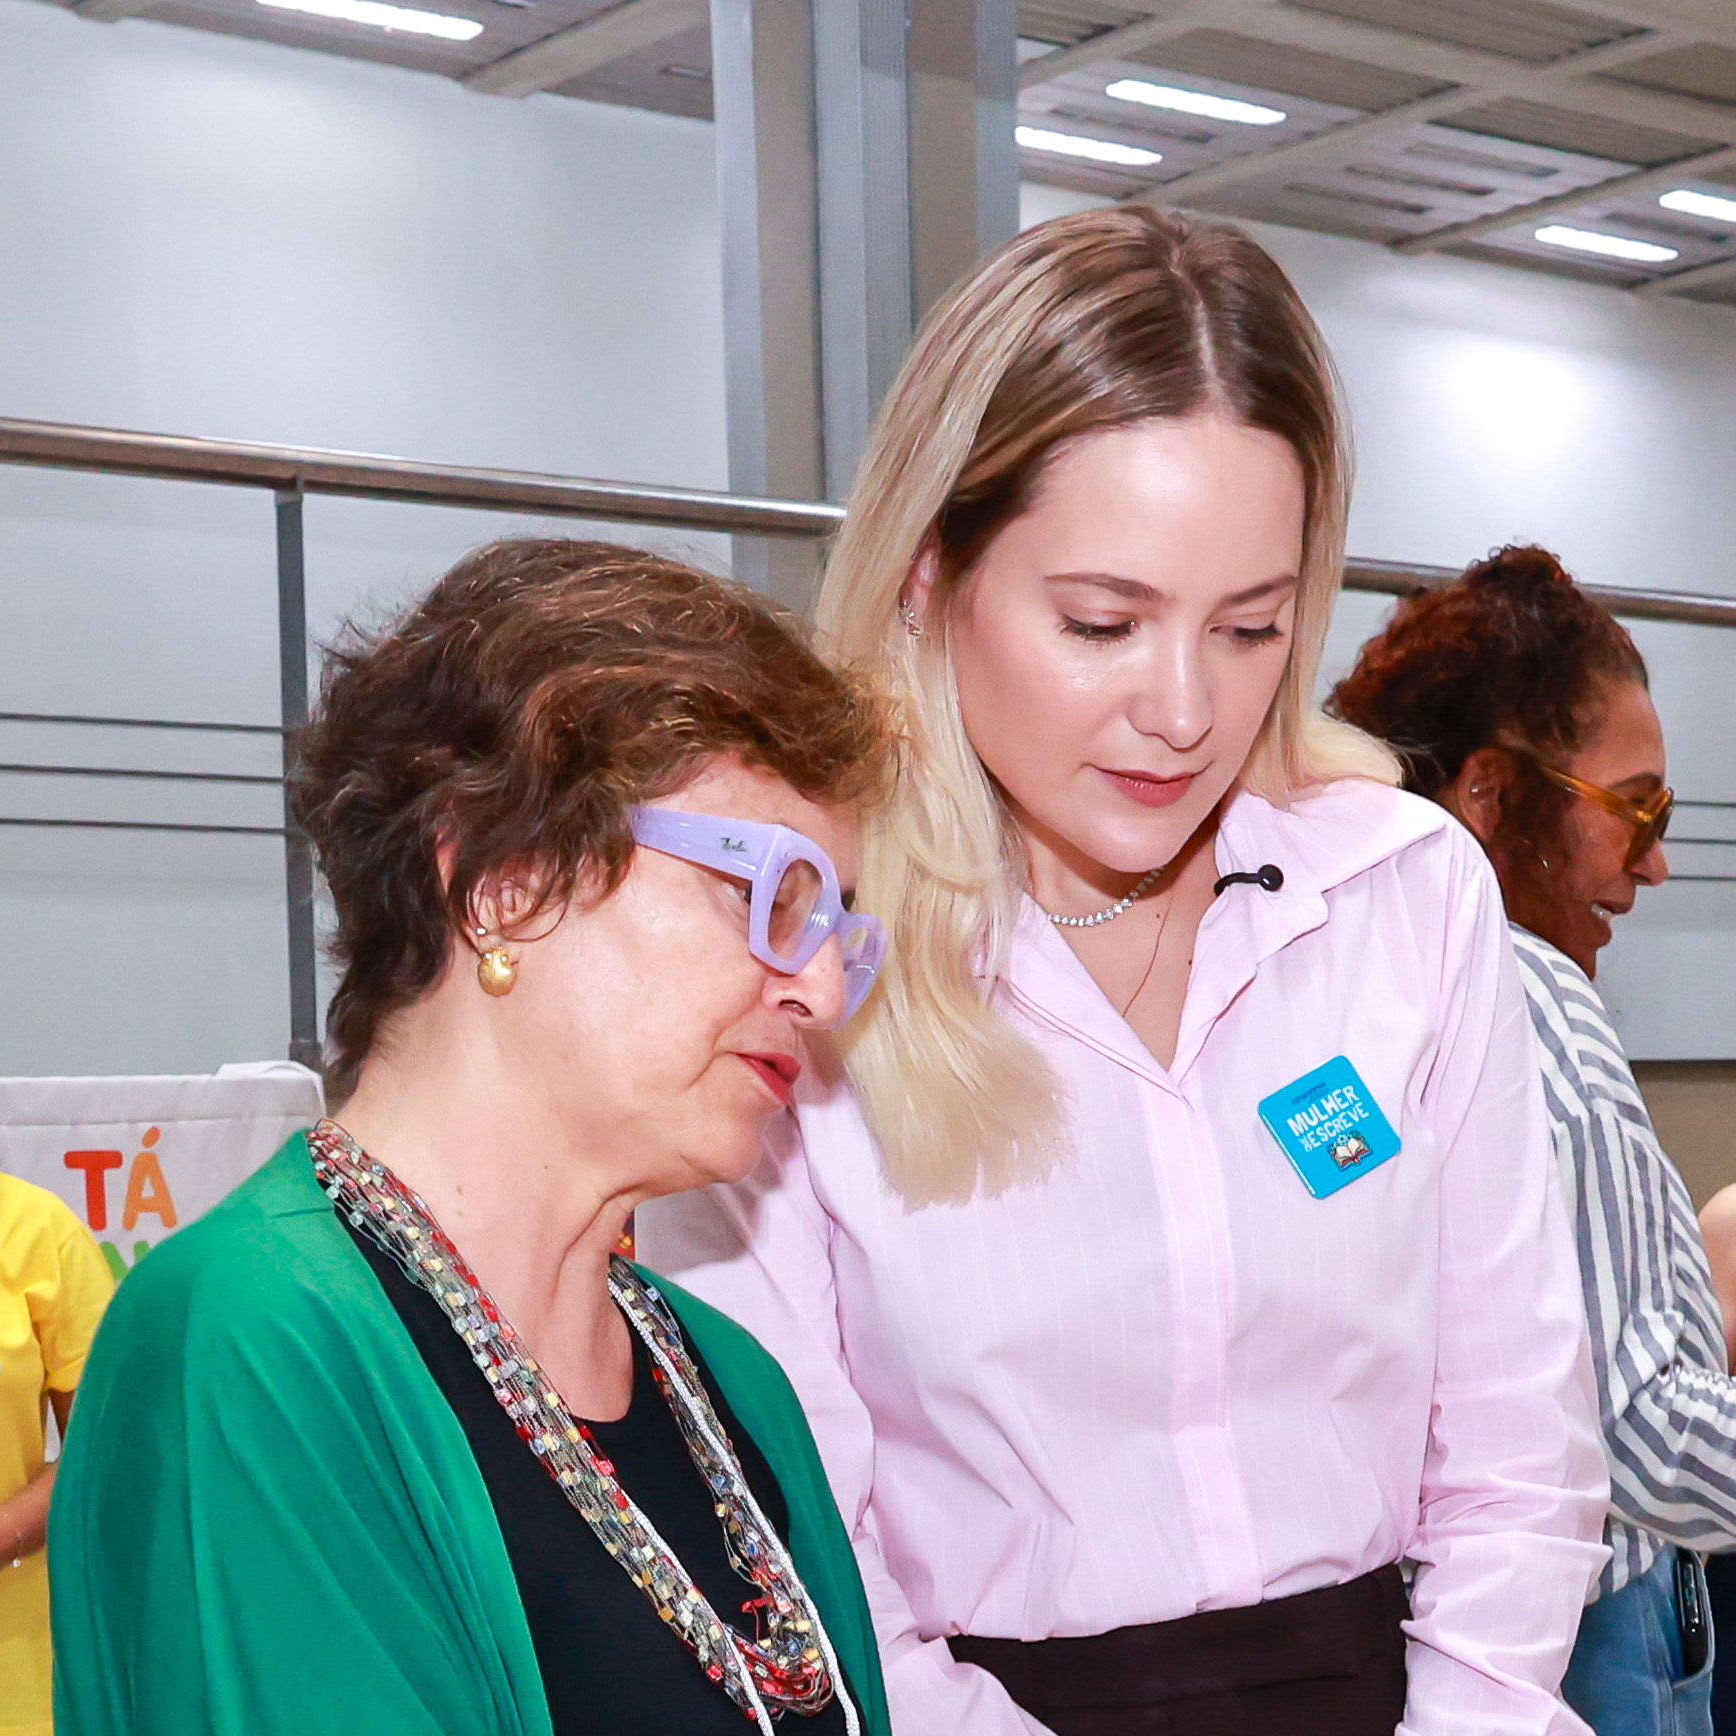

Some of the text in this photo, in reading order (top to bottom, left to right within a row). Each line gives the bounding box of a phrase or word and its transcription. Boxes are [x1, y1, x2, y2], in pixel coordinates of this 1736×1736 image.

[1287, 1085, 1360, 1136] MULHER
[1308, 1102, 1370, 1149] ESCREVE
[63, 1126, 178, 1231] TÁ
